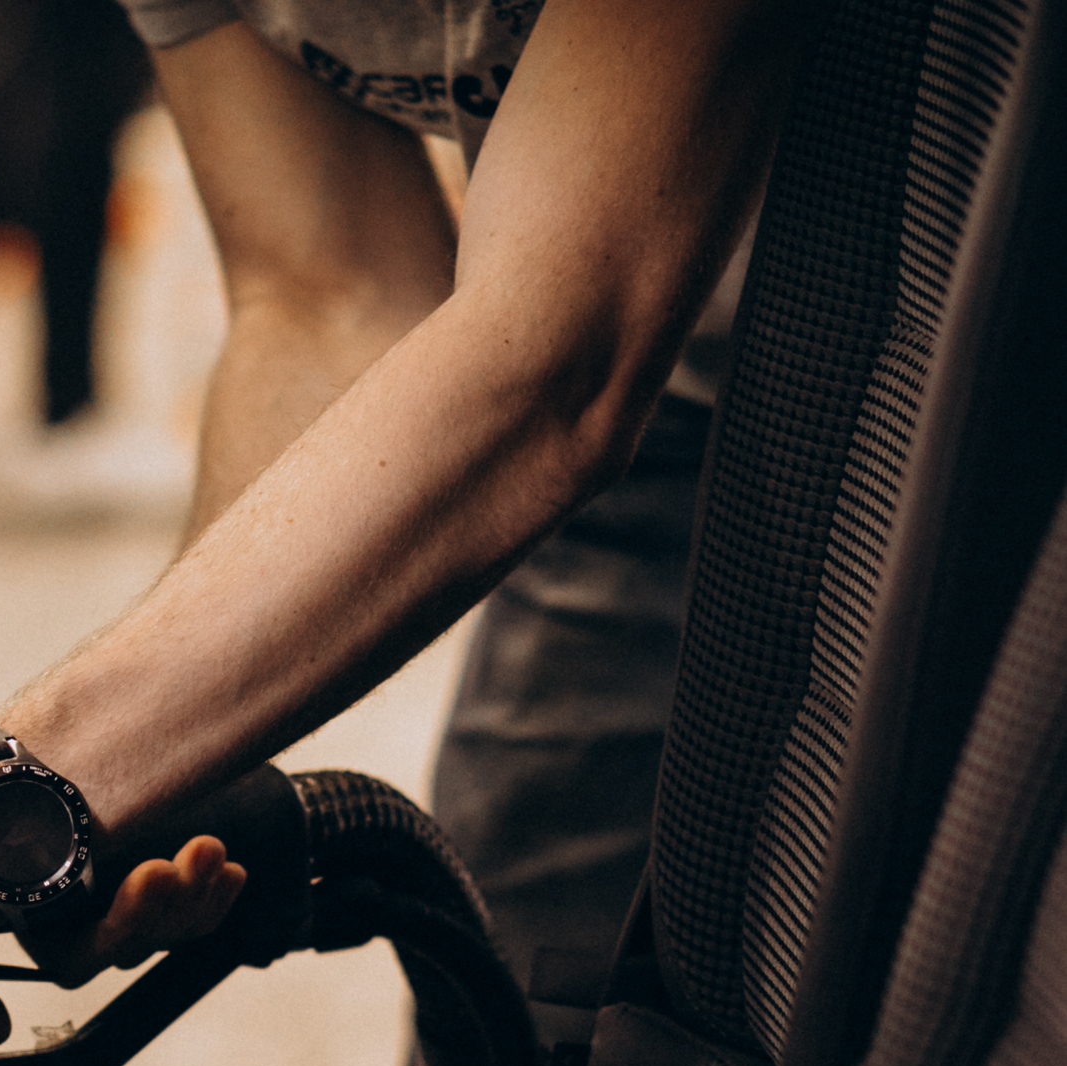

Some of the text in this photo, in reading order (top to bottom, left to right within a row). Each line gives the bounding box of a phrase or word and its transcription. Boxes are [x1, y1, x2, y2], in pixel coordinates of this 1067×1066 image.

[62, 784, 75, 796] 10
[79, 813, 88, 825] 15
[77, 846, 88, 861] 20
[57, 876, 71, 889] 25
[28, 892, 42, 902] 30
